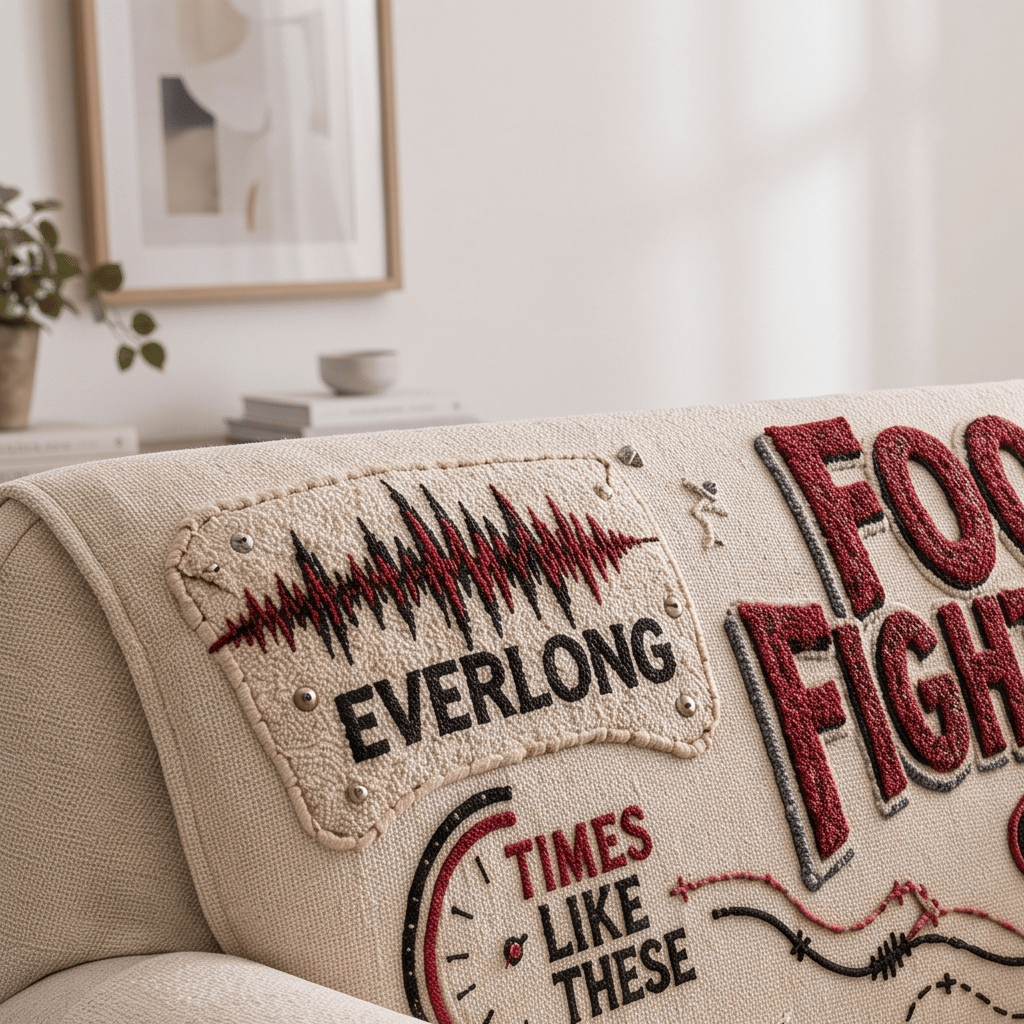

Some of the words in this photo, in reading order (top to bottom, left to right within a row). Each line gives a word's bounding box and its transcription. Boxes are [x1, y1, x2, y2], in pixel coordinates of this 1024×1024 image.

[334, 617, 677, 763] EVERLONG
[504, 805, 653, 900] TIMES
[538, 874, 650, 963] LIKE
[552, 928, 697, 1024] THESE
